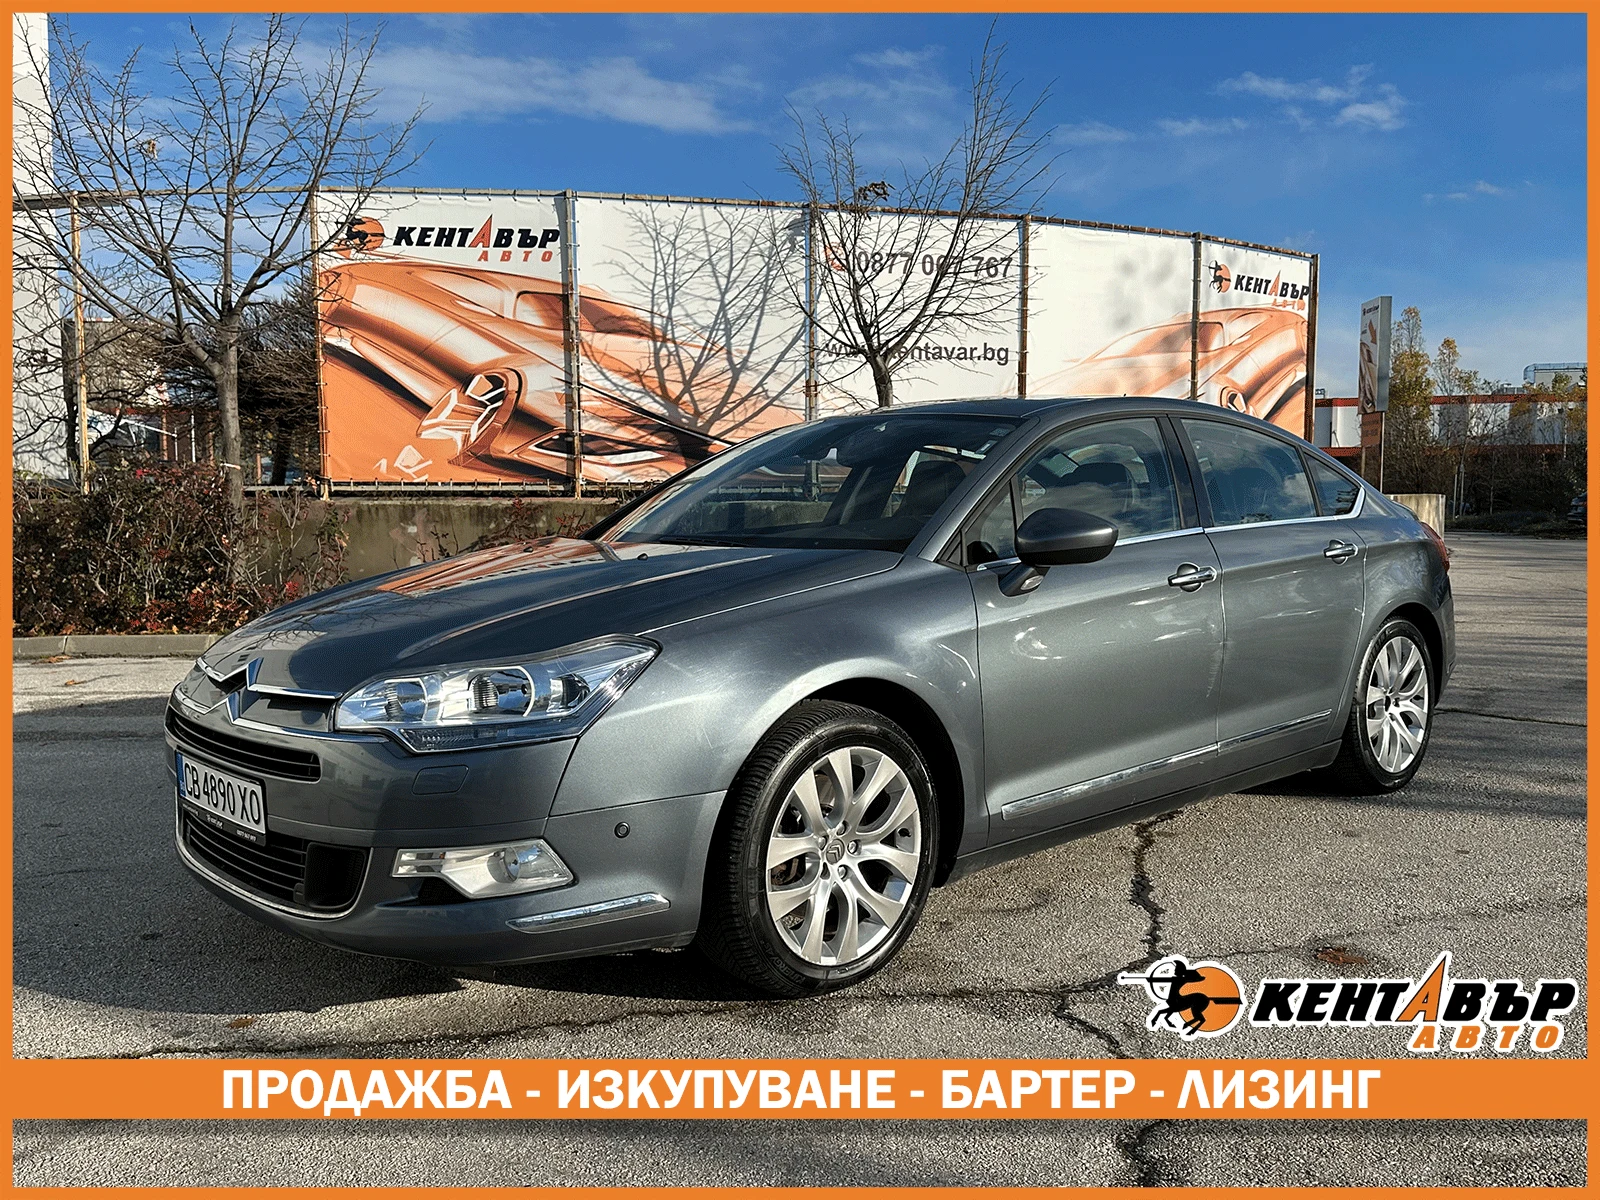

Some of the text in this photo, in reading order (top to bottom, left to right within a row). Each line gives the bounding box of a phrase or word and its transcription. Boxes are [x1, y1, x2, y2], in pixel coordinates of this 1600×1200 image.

[392, 214, 561, 249] КЕНТАВЪР
[477, 250, 554, 262] АВТО
[857, 251, 914, 275] 0877
[971, 255, 1013, 278] 767
[1234, 270, 1310, 300] КЕНТАВЪР
[202, 771, 236, 816] 4890
